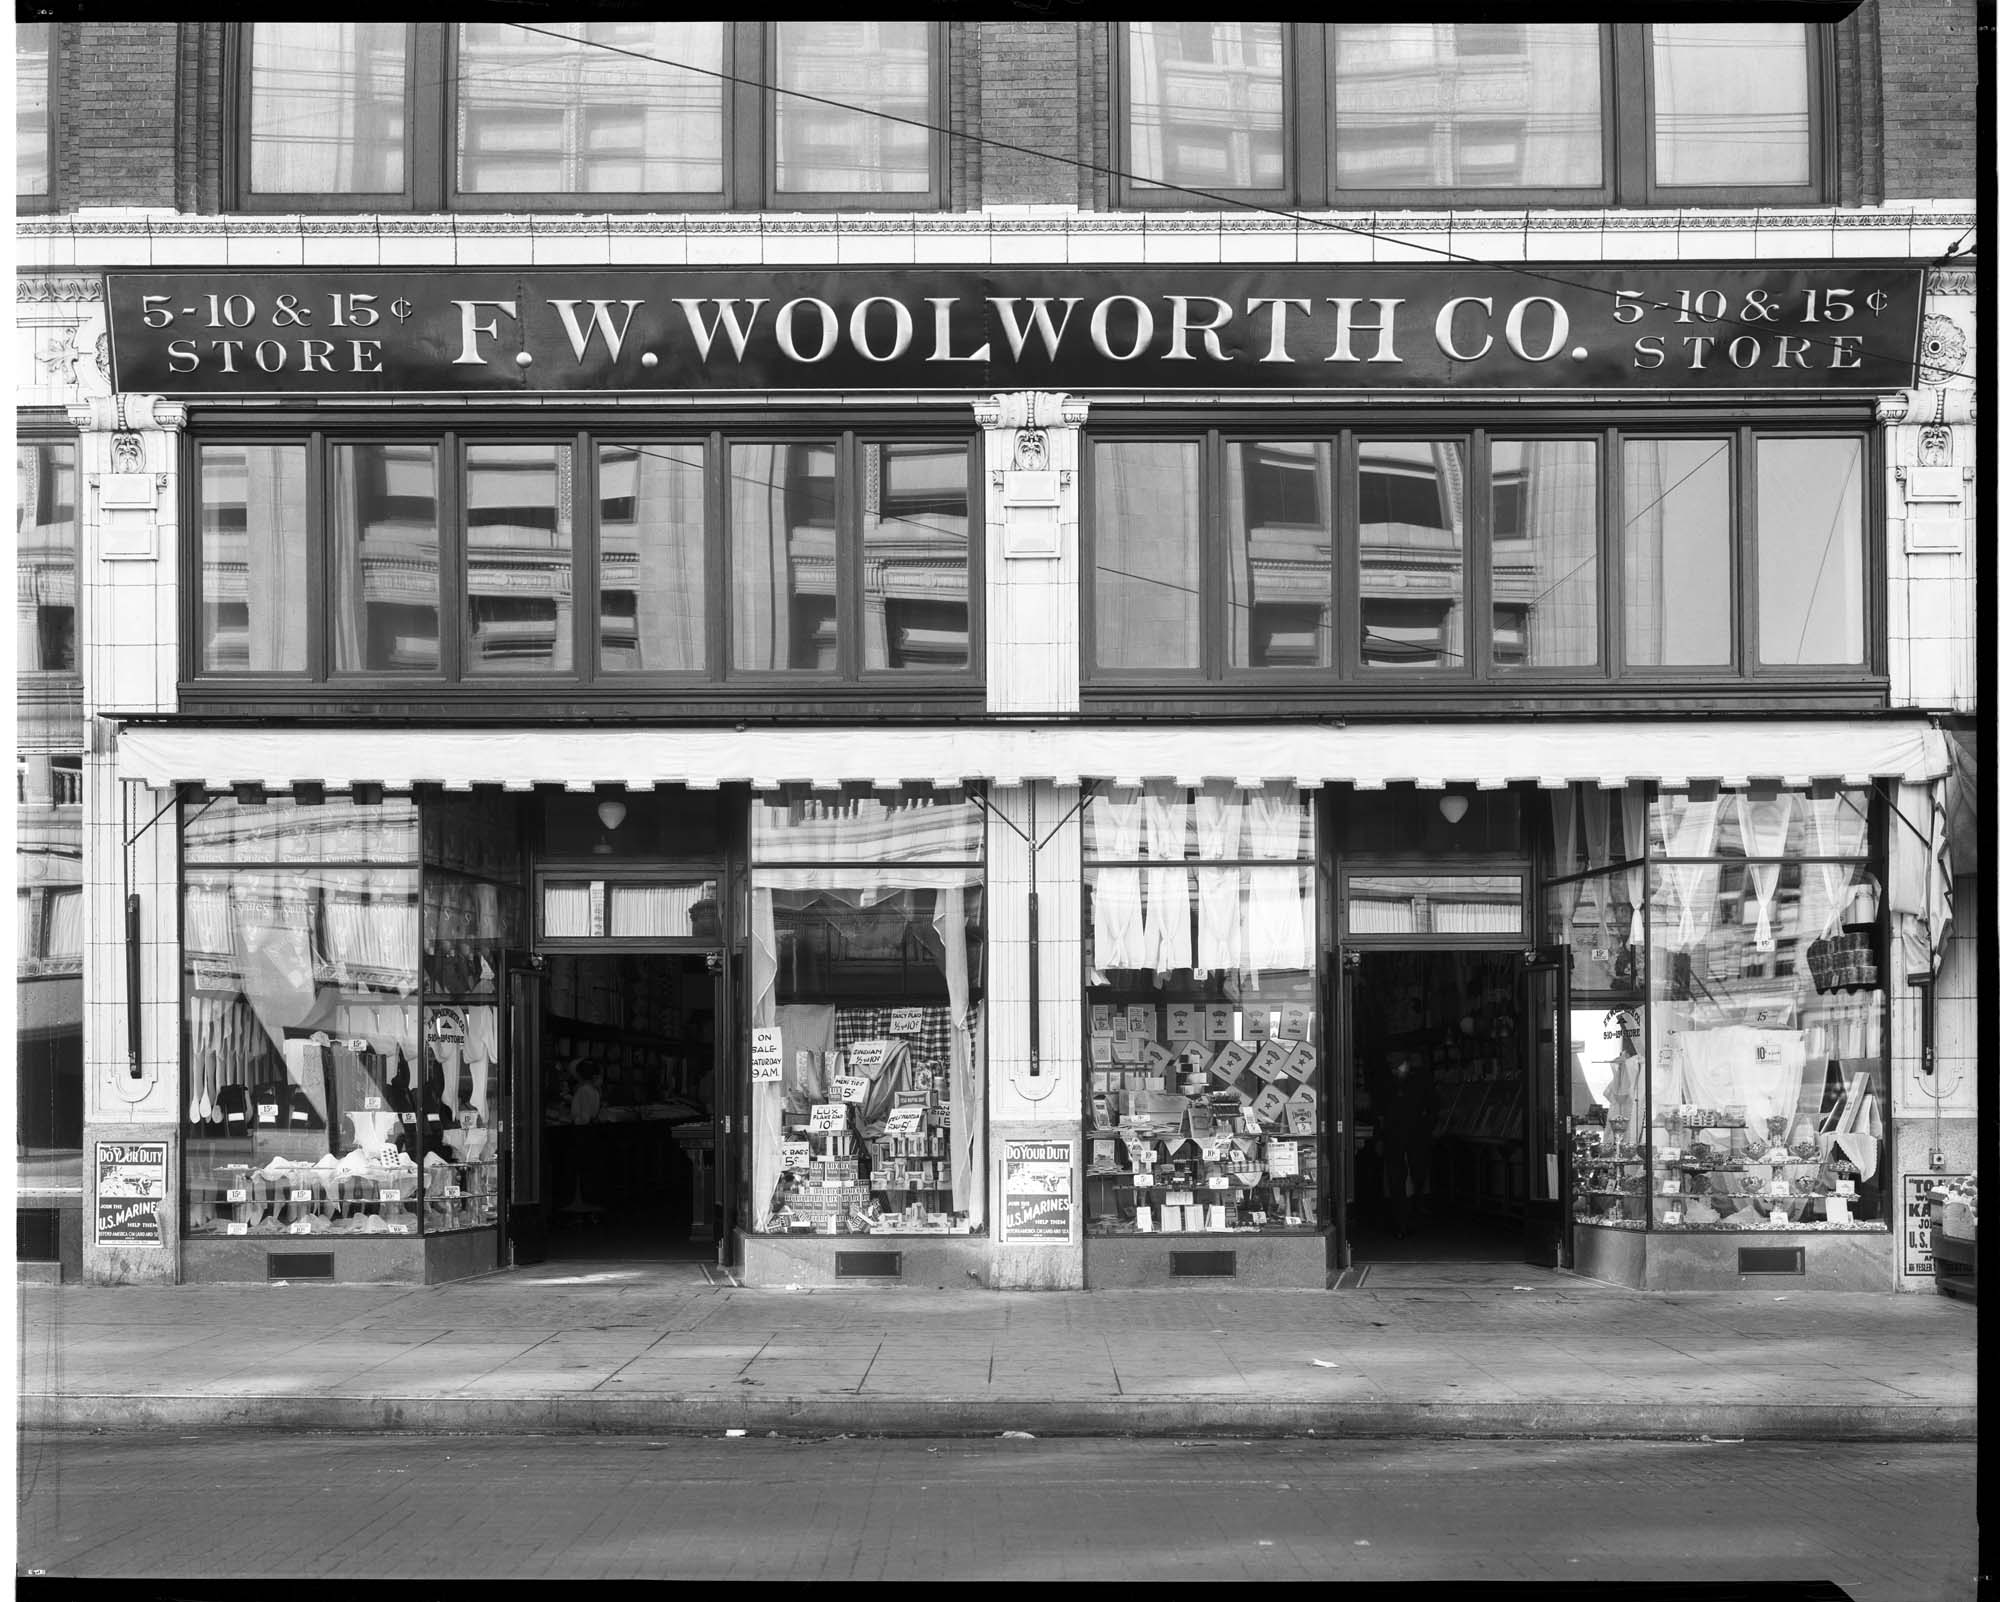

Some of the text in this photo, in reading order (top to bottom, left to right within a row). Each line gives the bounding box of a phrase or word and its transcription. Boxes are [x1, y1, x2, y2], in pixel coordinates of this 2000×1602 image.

[142, 292, 413, 328] 5-10 & 15¢
[1612, 288, 1890, 325] 5-10 & 15¢
[451, 295, 1590, 370] F. W. WOOLWORTH CO.
[167, 339, 385, 374] STORE
[1633, 335, 1865, 369] STORE
[752, 1045, 777, 1053] SALE
[100, 1148, 114, 1162] DO
[140, 1149, 163, 1163] DUTY
[1007, 1146, 1070, 1160] DO YOUR DUTY
[99, 1202, 159, 1230] U.S. MARINE
[1007, 1198, 1070, 1228] U.S. MARINES
[1908, 1203, 1931, 1217] KA
